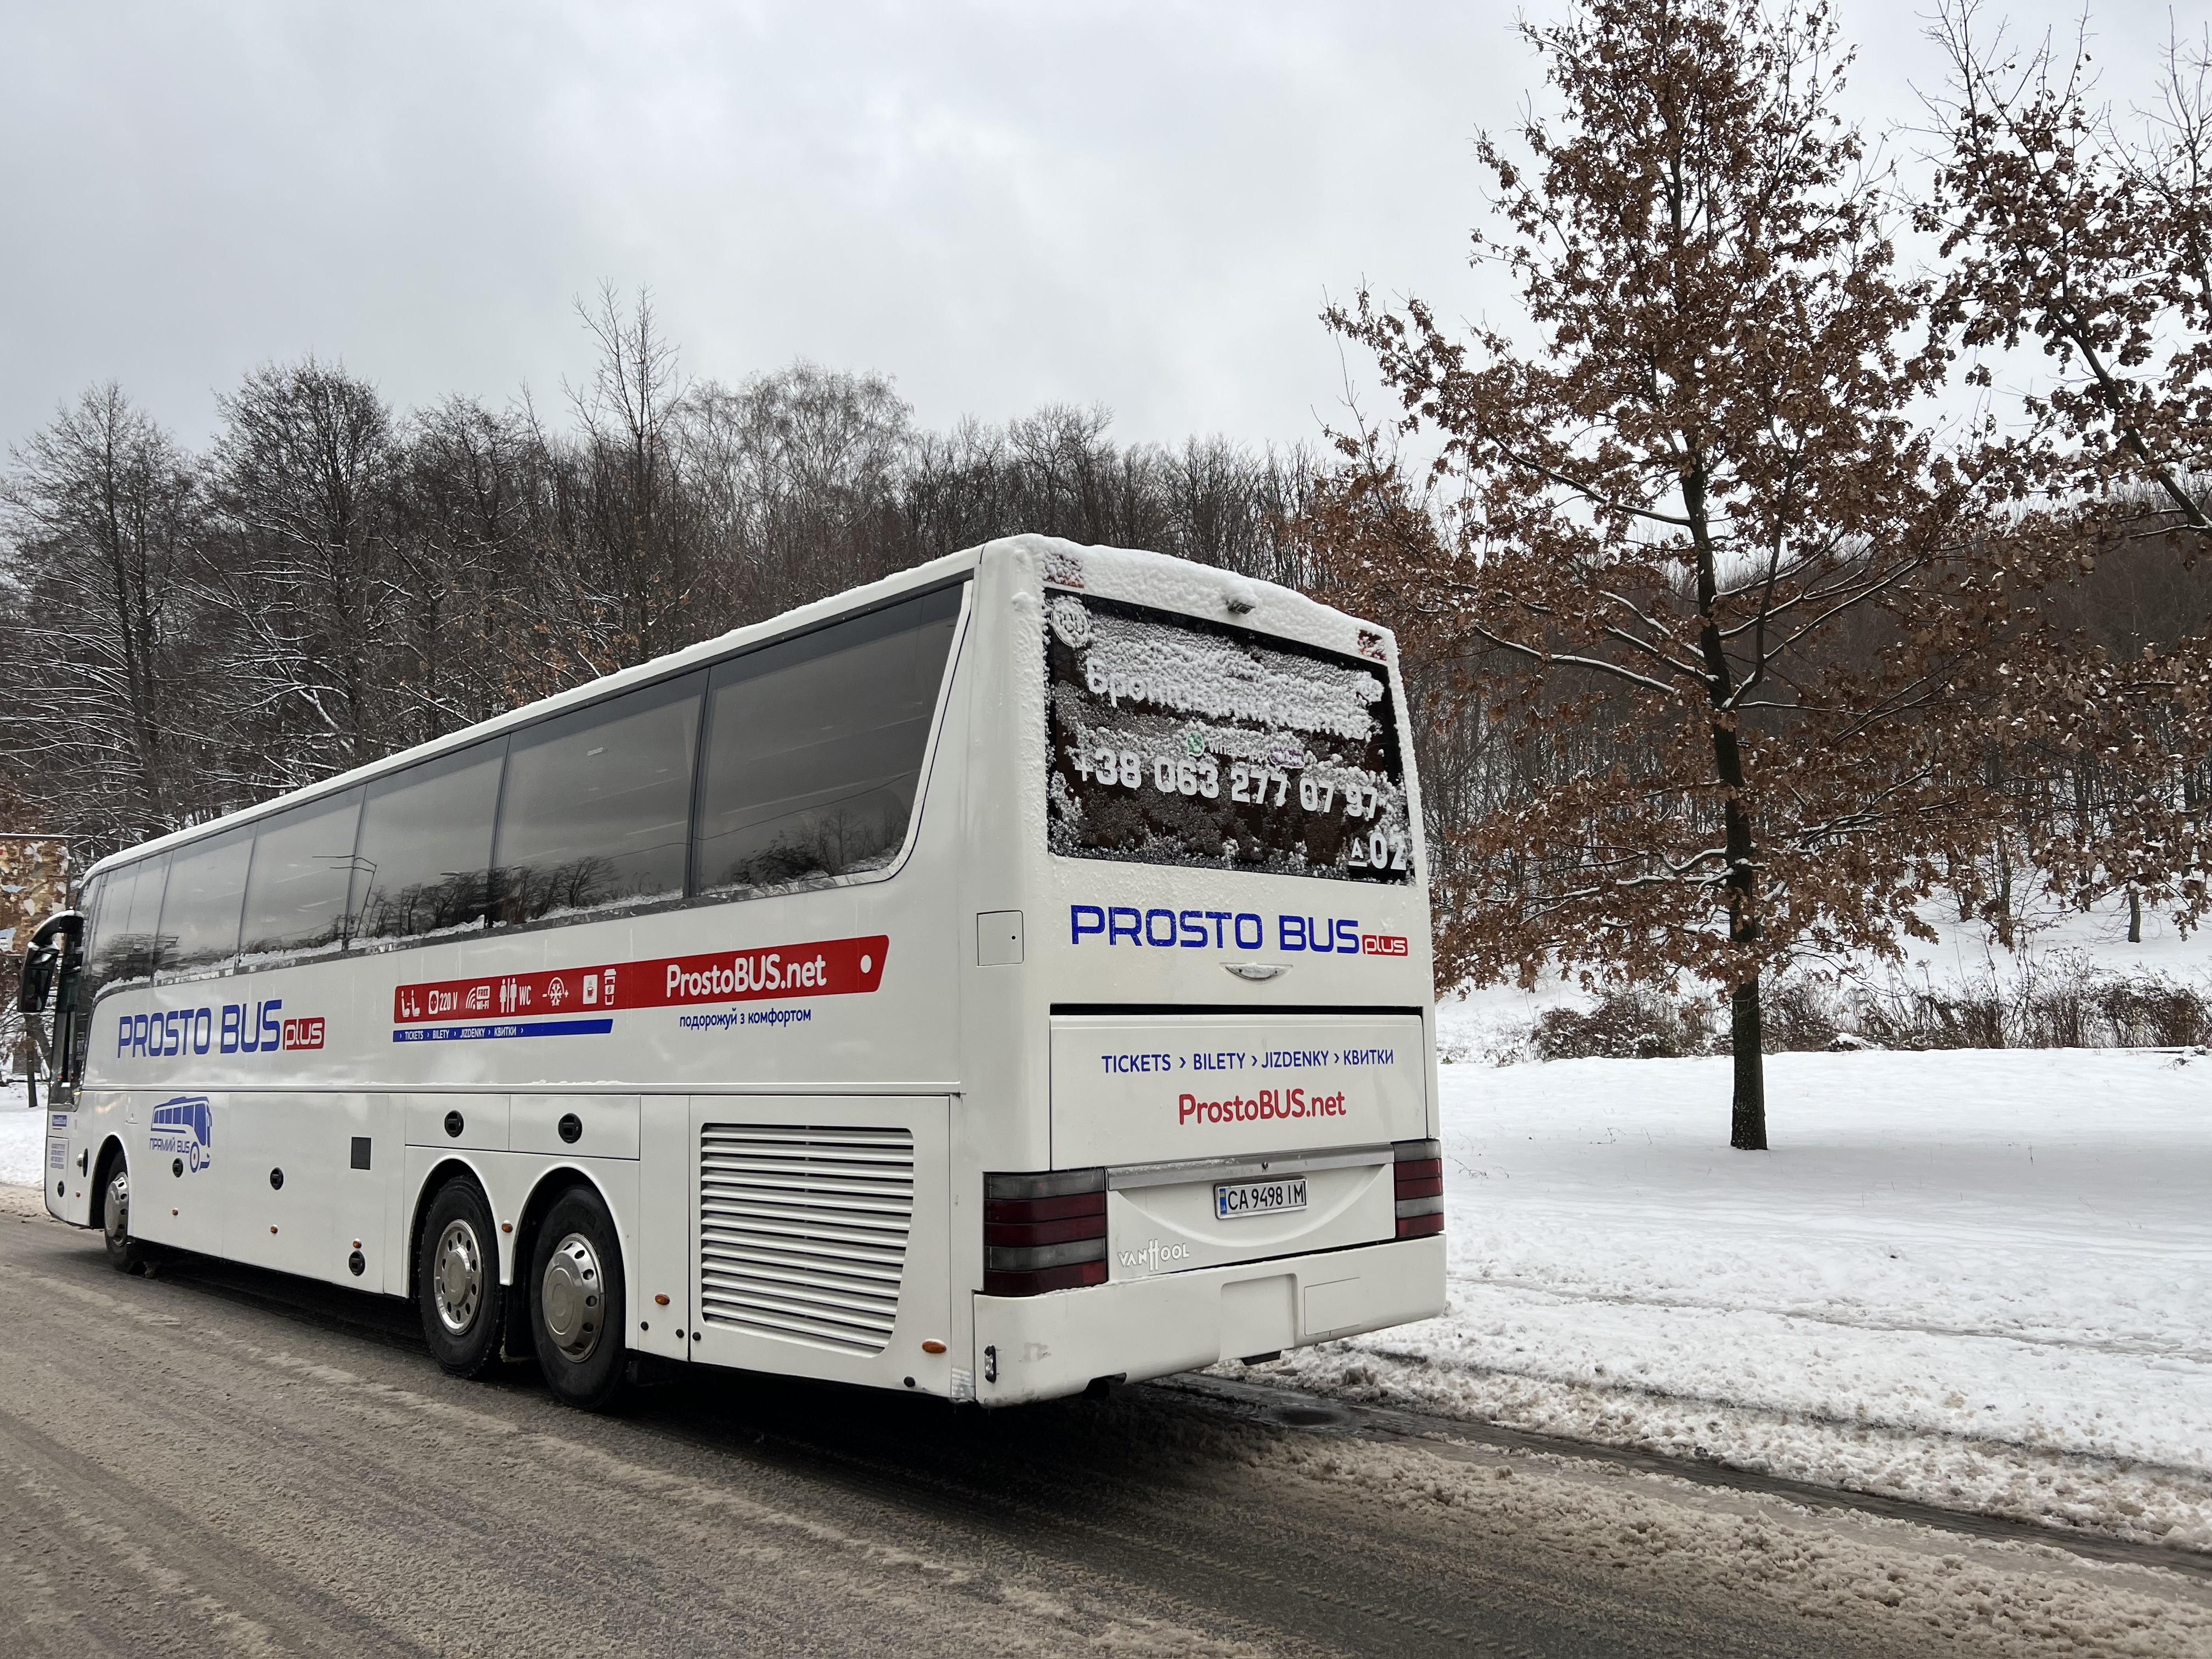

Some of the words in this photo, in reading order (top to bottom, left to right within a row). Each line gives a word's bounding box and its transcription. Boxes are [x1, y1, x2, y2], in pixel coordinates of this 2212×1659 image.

[1074, 747, 1142, 788] +38
[1153, 756, 1219, 798] 063
[1230, 766, 1288, 807] 277
[1299, 778, 1334, 813] 07
[1346, 783, 1378, 819] 97
[1071, 905, 1262, 950] PROSTO
[1279, 915, 1359, 954] BUS
[1364, 935, 1406, 955] plus
[667, 953, 827, 998] ProstoBUS.net
[439, 991, 452, 1011] 220
[453, 991, 459, 1010] V
[478, 989, 488, 997] FREE
[519, 985, 532, 1006] WC
[117, 1007, 211, 1058] PROSTO
[220, 999, 283, 1054] BUS
[285, 1018, 323, 1050] plus
[680, 1007, 737, 1031] подорожуй
[740, 1013, 745, 1024] з
[748, 1008, 811, 1027] комфортом
[405, 1030, 424, 1040] TICKETS
[432, 1029, 449, 1039] BILETY
[460, 1028, 486, 1038] JIZDENKY
[494, 1026, 516, 1036] КВИТКИ
[1102, 1053, 1171, 1073] TICKETS
[1193, 1052, 1245, 1070] BILETY
[1261, 1050, 1329, 1068] JIZDENKY
[1344, 1049, 1394, 1065] КВИТКИ
[1180, 1088, 1346, 1125] ProstoBUS.net
[177, 1140, 190, 1154] BUS
